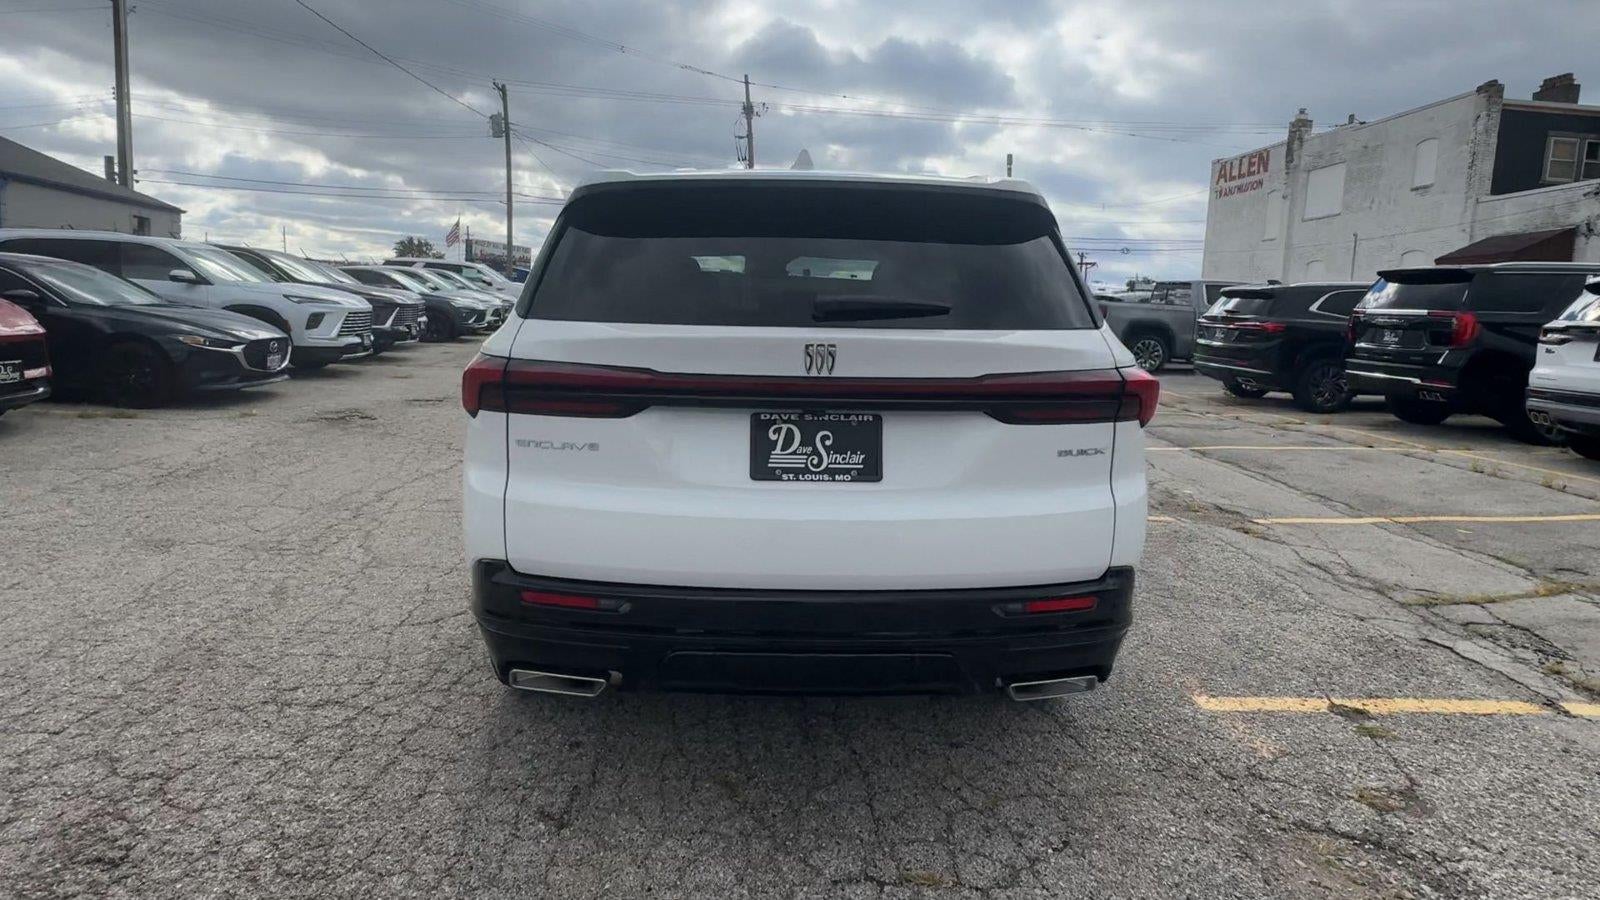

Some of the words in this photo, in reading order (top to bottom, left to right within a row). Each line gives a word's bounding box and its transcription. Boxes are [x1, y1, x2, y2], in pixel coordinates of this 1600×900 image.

[1216, 149, 1270, 185] ALLEN
[515, 439, 600, 451] ENCLAVE
[768, 423, 813, 455] Dave
[807, 430, 865, 472] Sinclair
[1056, 447, 1105, 458] BUICK
[782, 473, 797, 481] ST.
